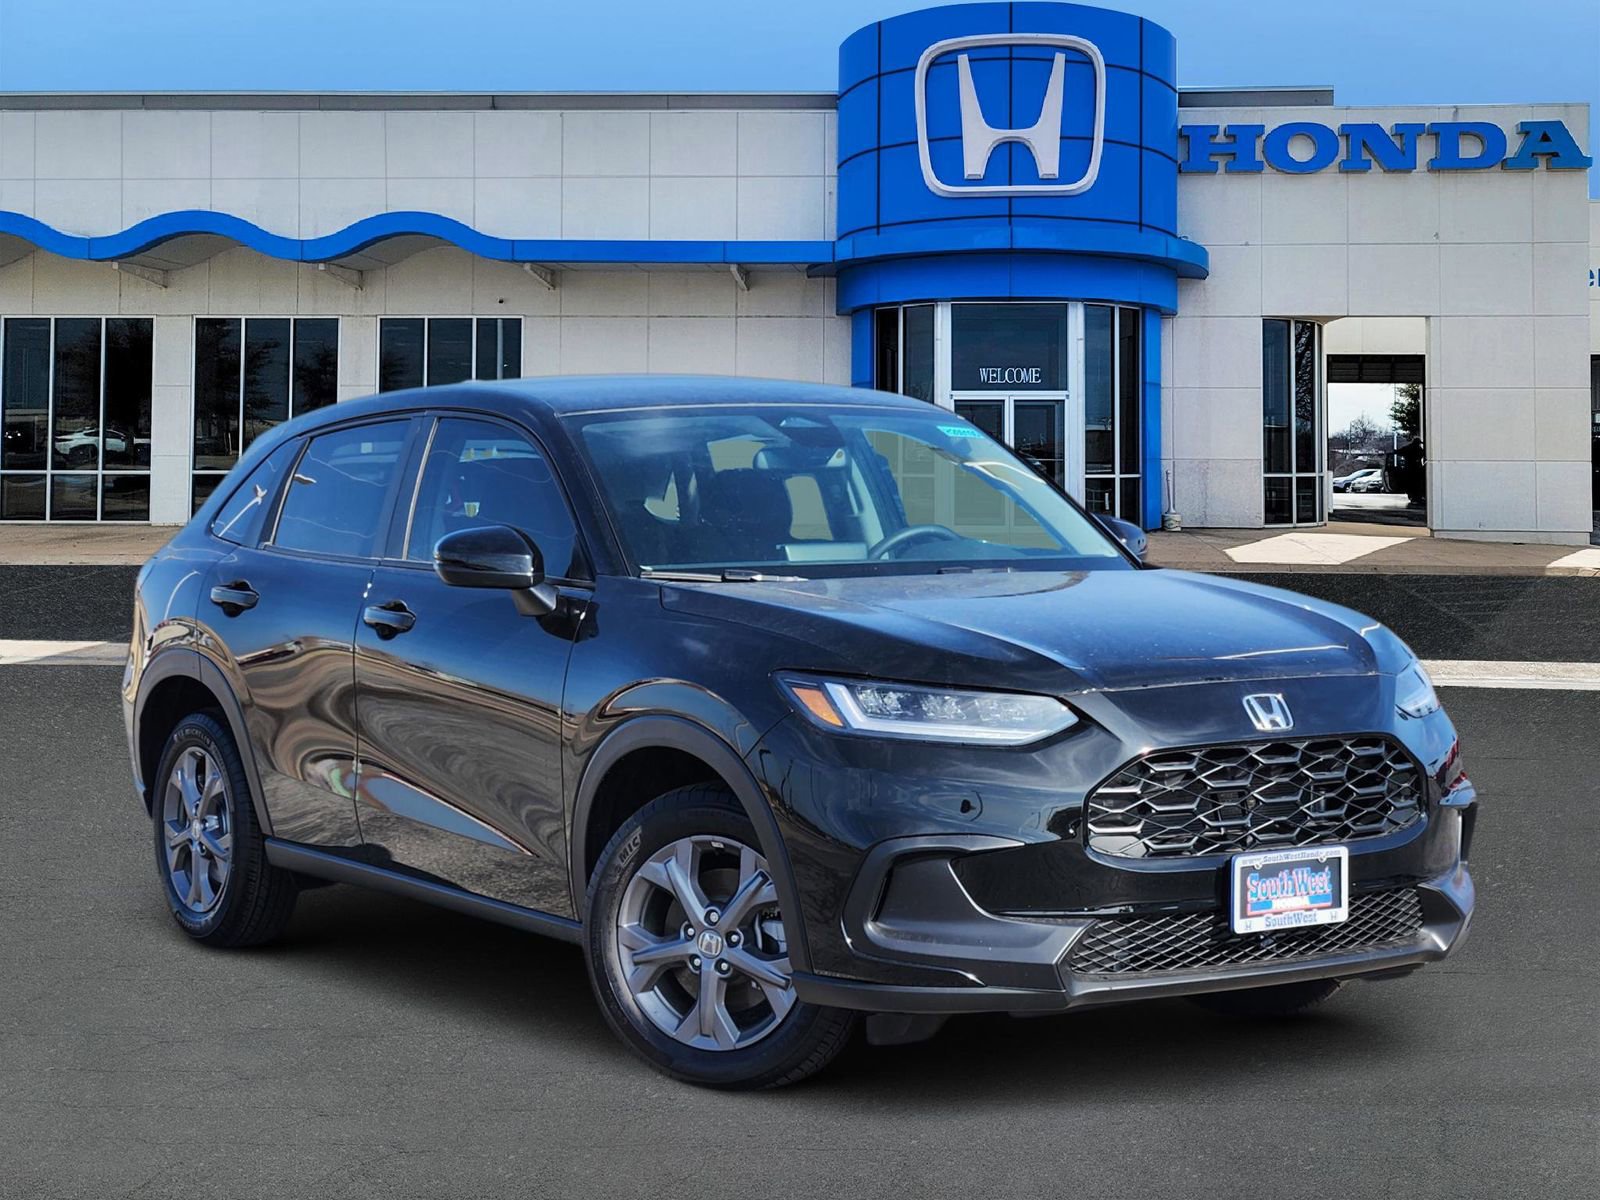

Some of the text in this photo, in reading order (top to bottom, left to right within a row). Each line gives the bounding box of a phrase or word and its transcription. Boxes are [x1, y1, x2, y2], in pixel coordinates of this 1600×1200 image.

[1179, 121, 1592, 175] HONDA
[979, 367, 1041, 384] WELCOME
[1246, 865, 1333, 902] SouthWest
[1264, 911, 1318, 928] SouthWest
